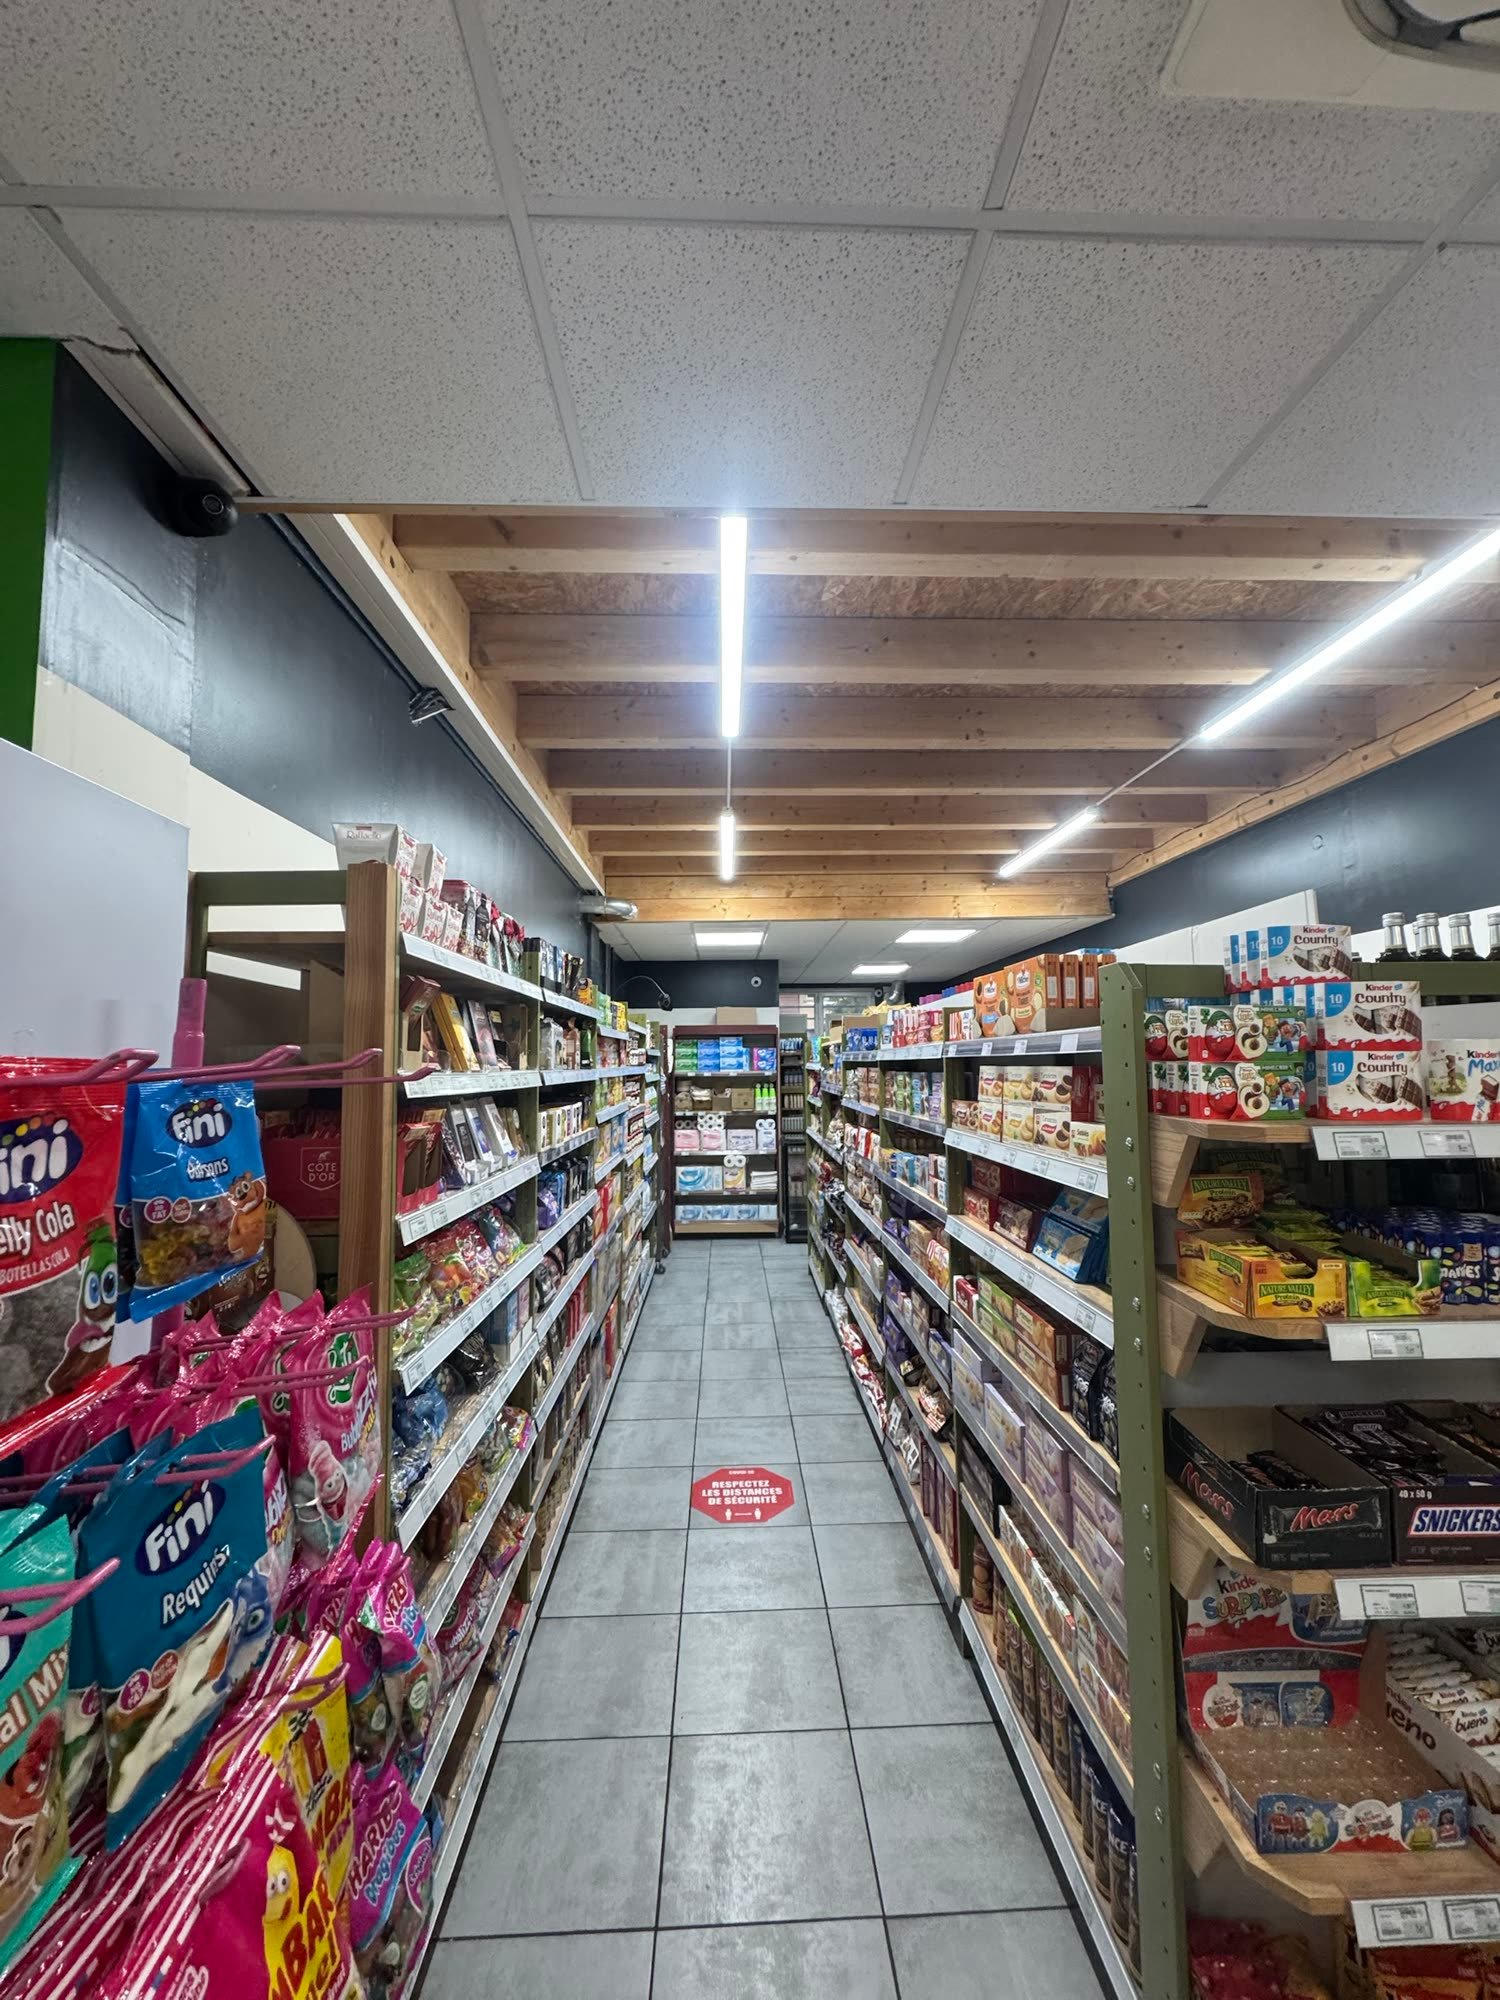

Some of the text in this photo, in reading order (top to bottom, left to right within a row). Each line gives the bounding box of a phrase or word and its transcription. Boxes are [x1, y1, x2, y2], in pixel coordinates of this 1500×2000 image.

[1303, 926, 1327, 934] Kinder
[1271, 936, 1284, 946] 10
[1293, 934, 1339, 947] Country
[1365, 983, 1393, 991] Kinder
[1329, 994, 1343, 1004] 10
[1355, 992, 1406, 1006] Country
[1368, 1052, 1395, 1061] Kinder
[1331, 1062, 1345, 1073] 10
[1357, 1061, 1408, 1075] Country
[171, 1103, 226, 1143] Fini
[0, 1118, 69, 1195] ini
[307, 1160, 337, 1172] CÔTE
[308, 1173, 336, 1182] D'OR
[1221, 1179, 1249, 1191] VALLEY
[35, 1201, 75, 1243] Cola
[0, 1256, 52, 1284] BOTELLAS
[1439, 1263, 1481, 1280] MARTIES
[1260, 1283, 1314, 1296] NATURE VALLEY
[712, 1480, 770, 1488] RESPECTEZ
[1180, 1461, 1234, 1520] Mars
[722, 1487, 782, 1496] DISTANCES
[1399, 1490, 1408, 1498] 40
[1416, 1490, 1426, 1498] 50
[708, 1494, 777, 1505] DE SÉCURITÉ
[1290, 1503, 1359, 1533] Mars
[1413, 1509, 1500, 1533] SNICKERS
[144, 1479, 214, 1572] Fini
[161, 1545, 230, 1625] Requins
[1217, 1575, 1258, 1594] Kinde
[1202, 1586, 1287, 1620] SURPRISE
[0, 1694, 27, 1744] al
[1386, 1701, 1436, 1750] eno
[1455, 1716, 1489, 1733] bueno
[364, 1818, 406, 1908] Dragibus
